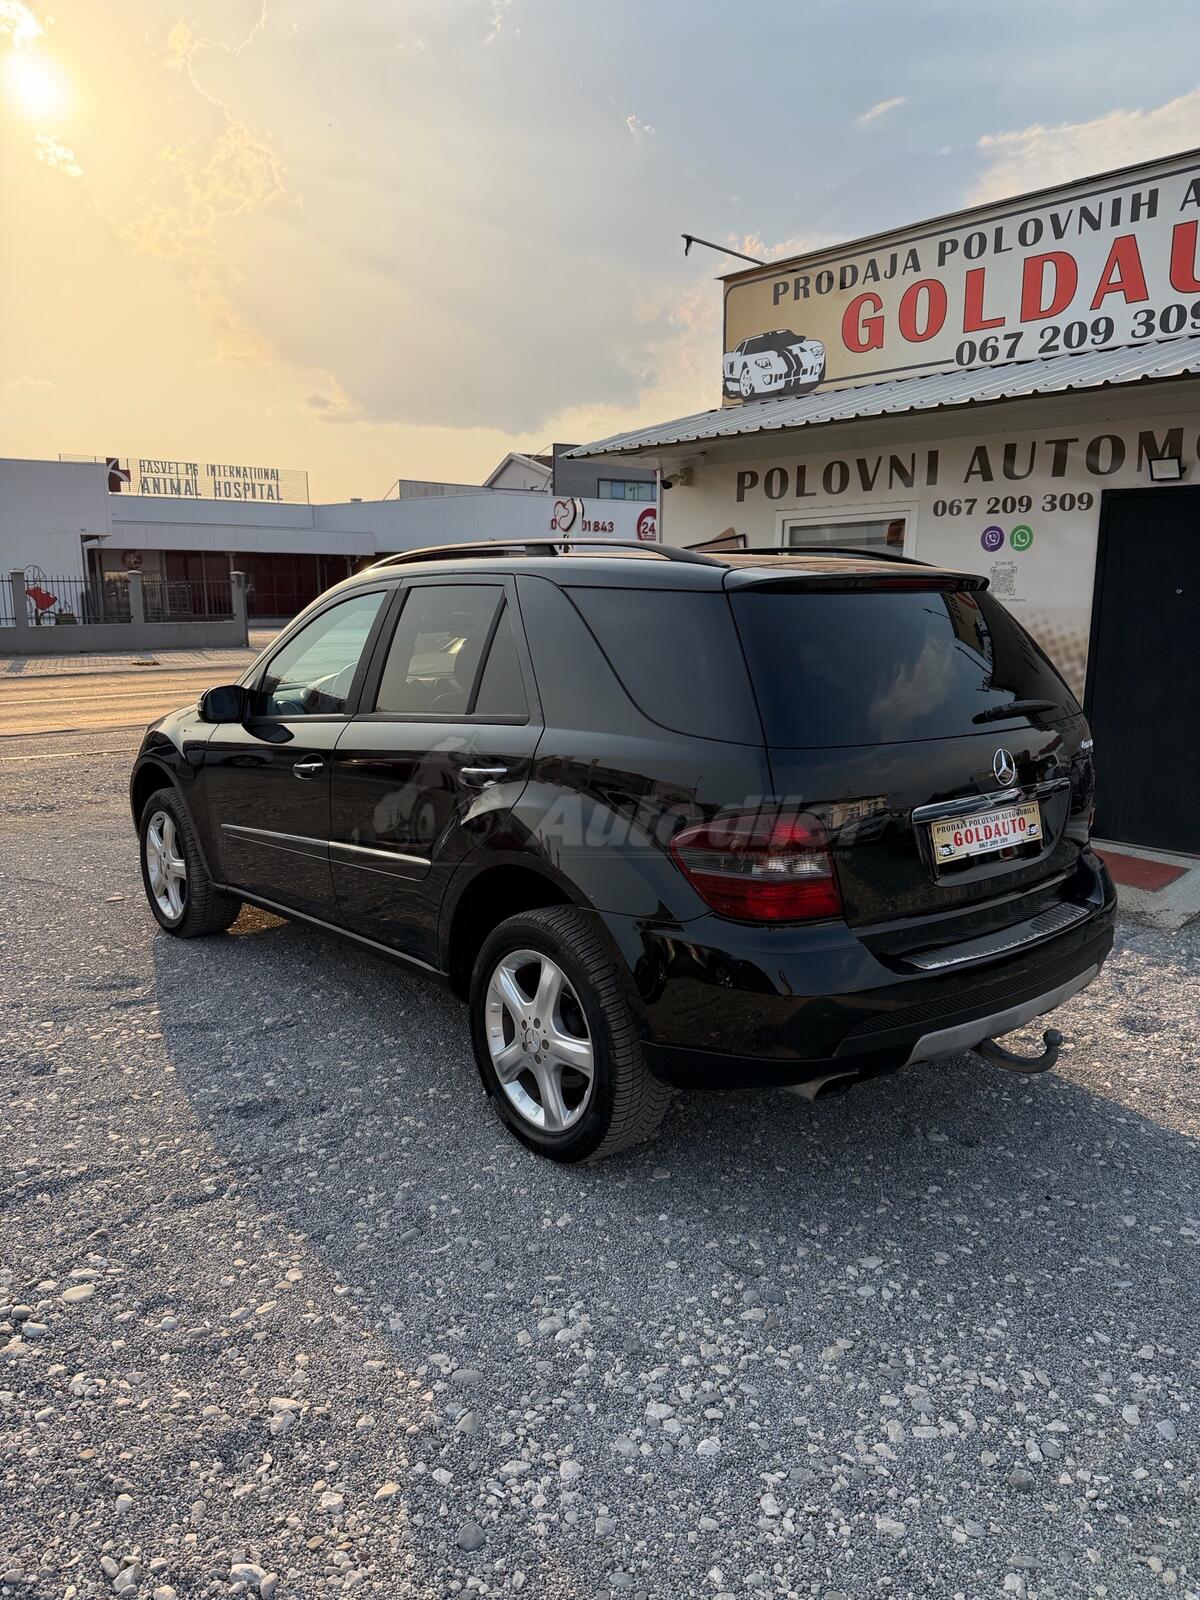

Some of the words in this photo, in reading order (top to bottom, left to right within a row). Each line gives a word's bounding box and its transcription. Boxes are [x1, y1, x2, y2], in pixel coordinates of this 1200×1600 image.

[772, 248, 921, 306] PRODAJA
[937, 188, 1159, 267] POLOVNIH
[955, 331, 1023, 366] 067
[1039, 316, 1115, 354] 209
[139, 459, 179, 475] HASVET
[206, 464, 282, 481] INTERNATIONAL
[736, 450, 939, 502] POLOVNI
[964, 426, 1200, 484] AUTOM
[142, 476, 202, 496] ANIMAL
[214, 480, 283, 501] HOSPITAL
[932, 498, 977, 517] 067
[986, 495, 1032, 515] 209
[1041, 491, 1094, 512] 309
[936, 822, 968, 834] PRODAJA
[1001, 807, 1036, 820] AUTOMOBILA
[953, 816, 1026, 847] GOLDAUTO
